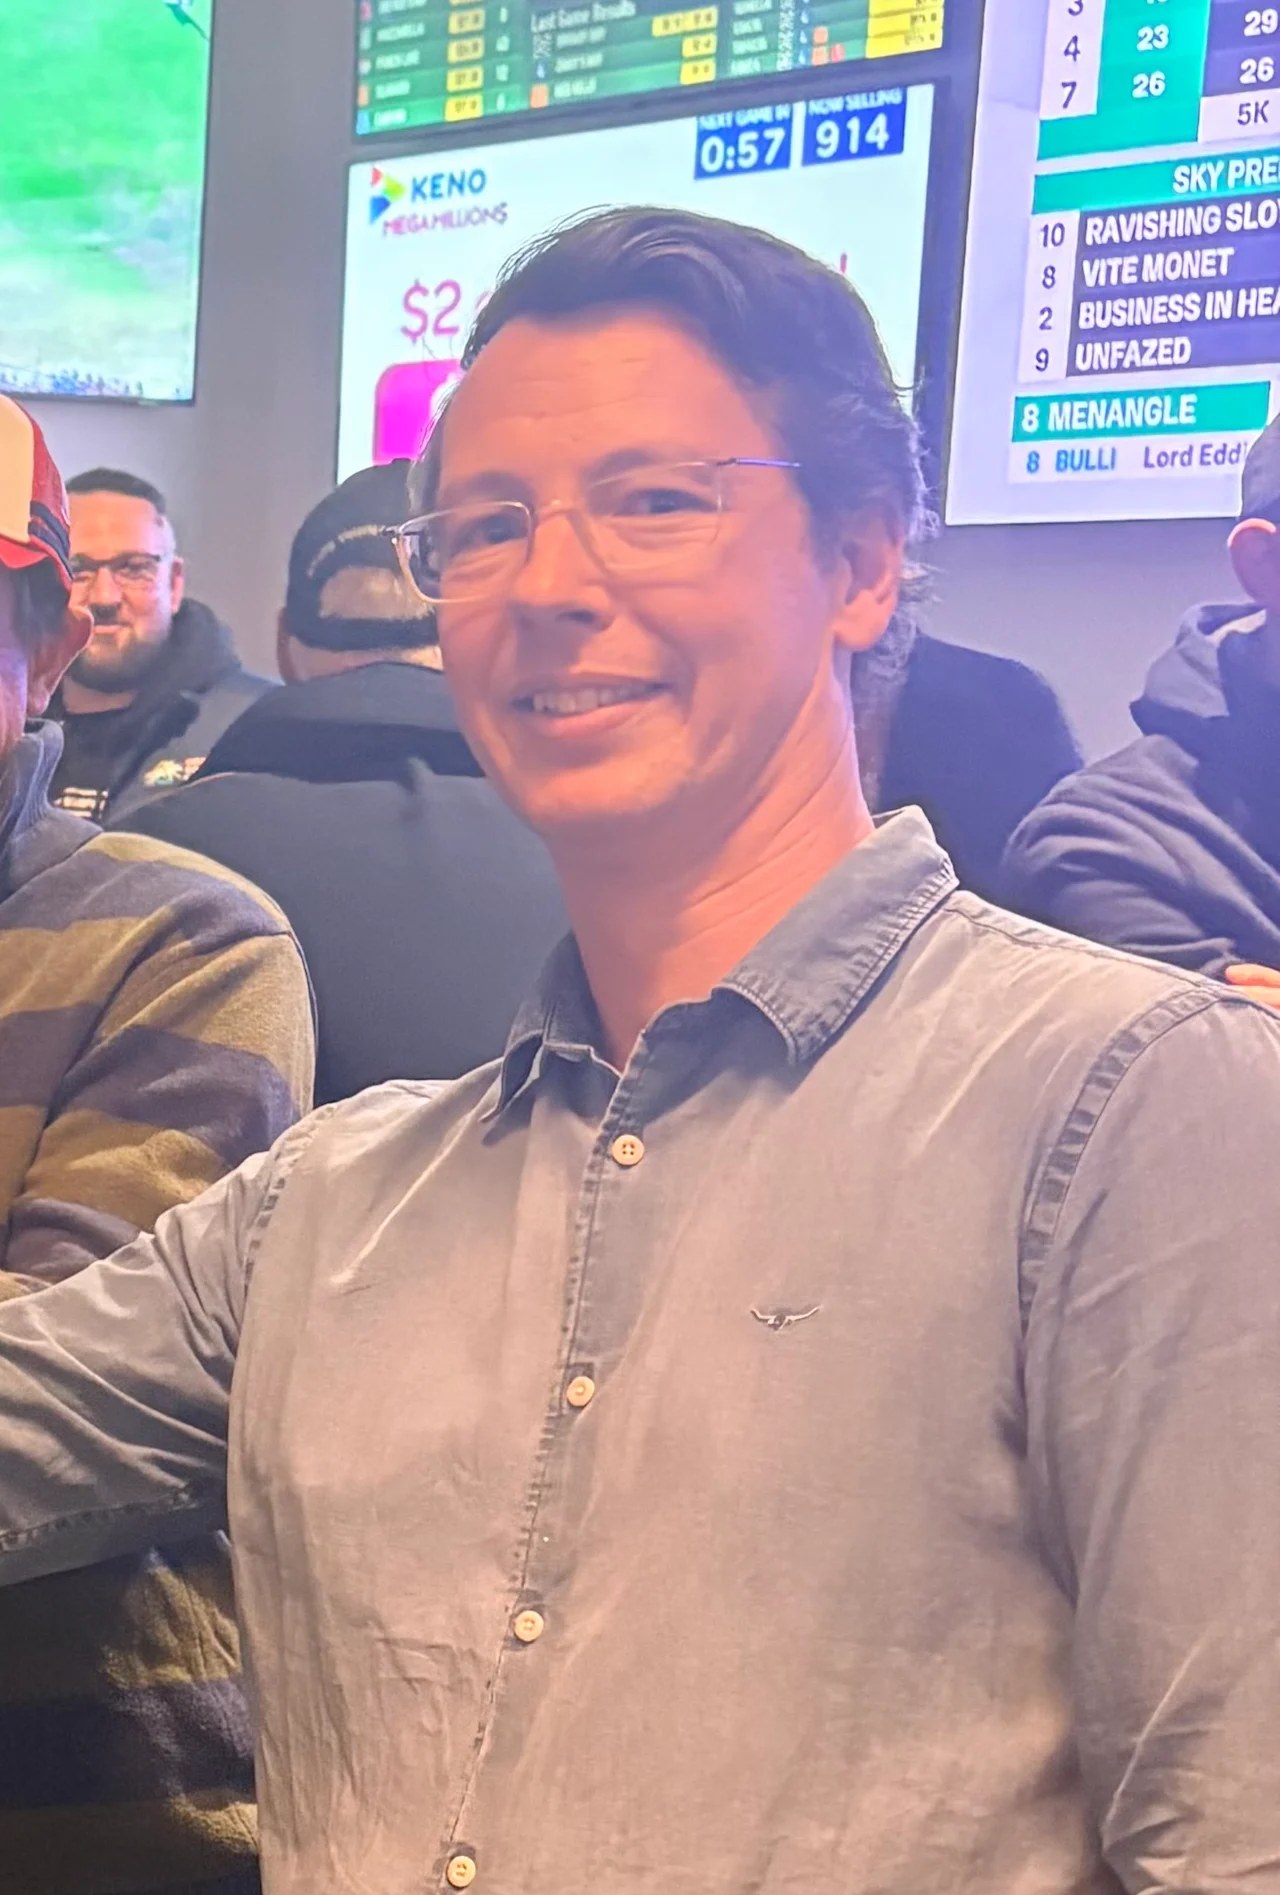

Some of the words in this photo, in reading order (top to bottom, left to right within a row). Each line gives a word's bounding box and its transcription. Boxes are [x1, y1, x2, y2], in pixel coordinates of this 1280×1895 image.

[1243, 8, 1279, 37] 29
[1063, 35, 1081, 62] 4
[1136, 24, 1170, 51] 23
[1239, 56, 1275, 84] 26
[808, 96, 843, 116] NOW
[845, 87, 903, 112] SELLING
[1061, 81, 1077, 109] 7
[1132, 71, 1166, 98] 26
[699, 127, 786, 173] 0:57
[815, 112, 890, 159] 914
[411, 168, 488, 203] KENO
[1172, 159, 1225, 194] SKY
[1040, 222, 1066, 247] 10
[1085, 204, 1221, 246] RAVISHING
[1225, 198, 1280, 233] SLO
[1041, 265, 1057, 289] 8
[1082, 255, 1139, 288] VITE
[1141, 246, 1236, 284] MONET
[1038, 306, 1054, 331] 2
[1078, 291, 1201, 330] BUSINESS
[1204, 289, 1234, 321] IN
[1034, 347, 1050, 372] 9
[1075, 335, 1192, 372] UNFAZED
[1021, 402, 1040, 433] 8
[1047, 392, 1199, 433] MENANGLE
[1026, 449, 1041, 474] 8
[1055, 446, 1117, 474] BULLI
[1143, 444, 1195, 469] Lord
